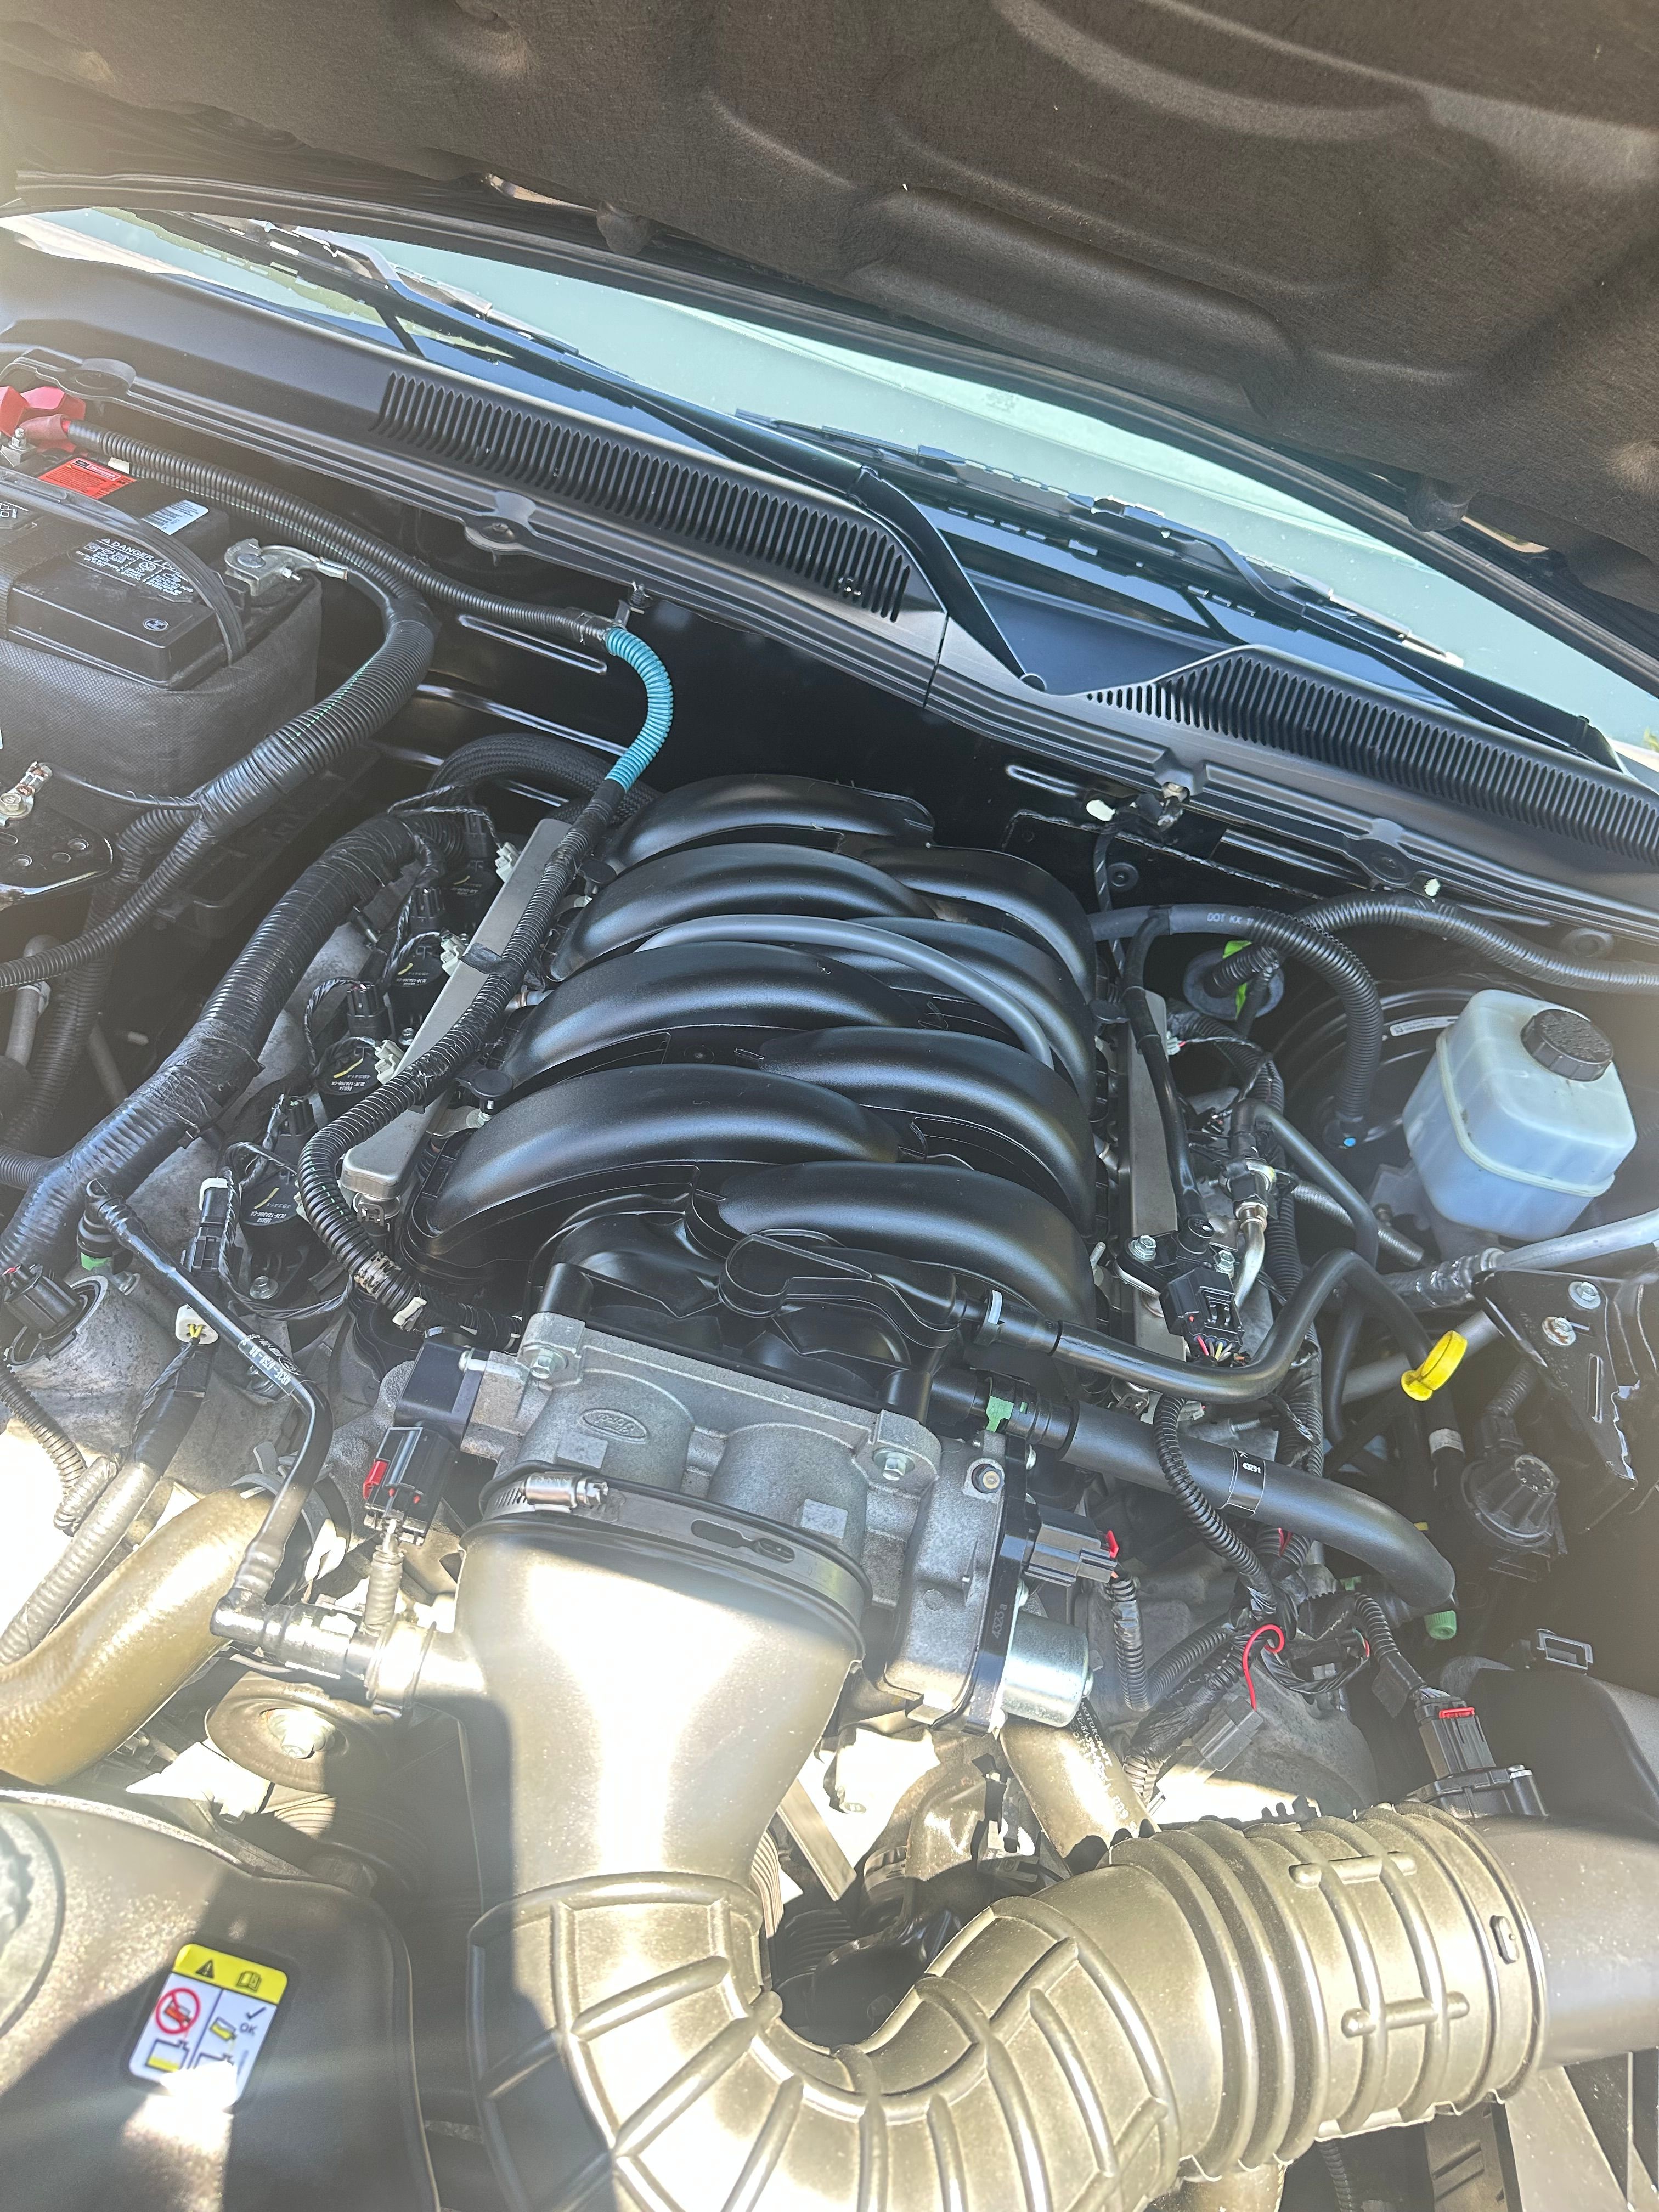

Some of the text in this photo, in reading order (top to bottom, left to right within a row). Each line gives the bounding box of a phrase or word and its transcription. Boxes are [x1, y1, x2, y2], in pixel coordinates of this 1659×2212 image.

[111, 541, 154, 561] DANGER
[1207, 912, 1225, 922] DOT
[991, 1610, 1005, 1639] 4323
[1080, 1702, 1113, 1767] MOTORCRAFT
[239, 2022, 258, 2036] OK
